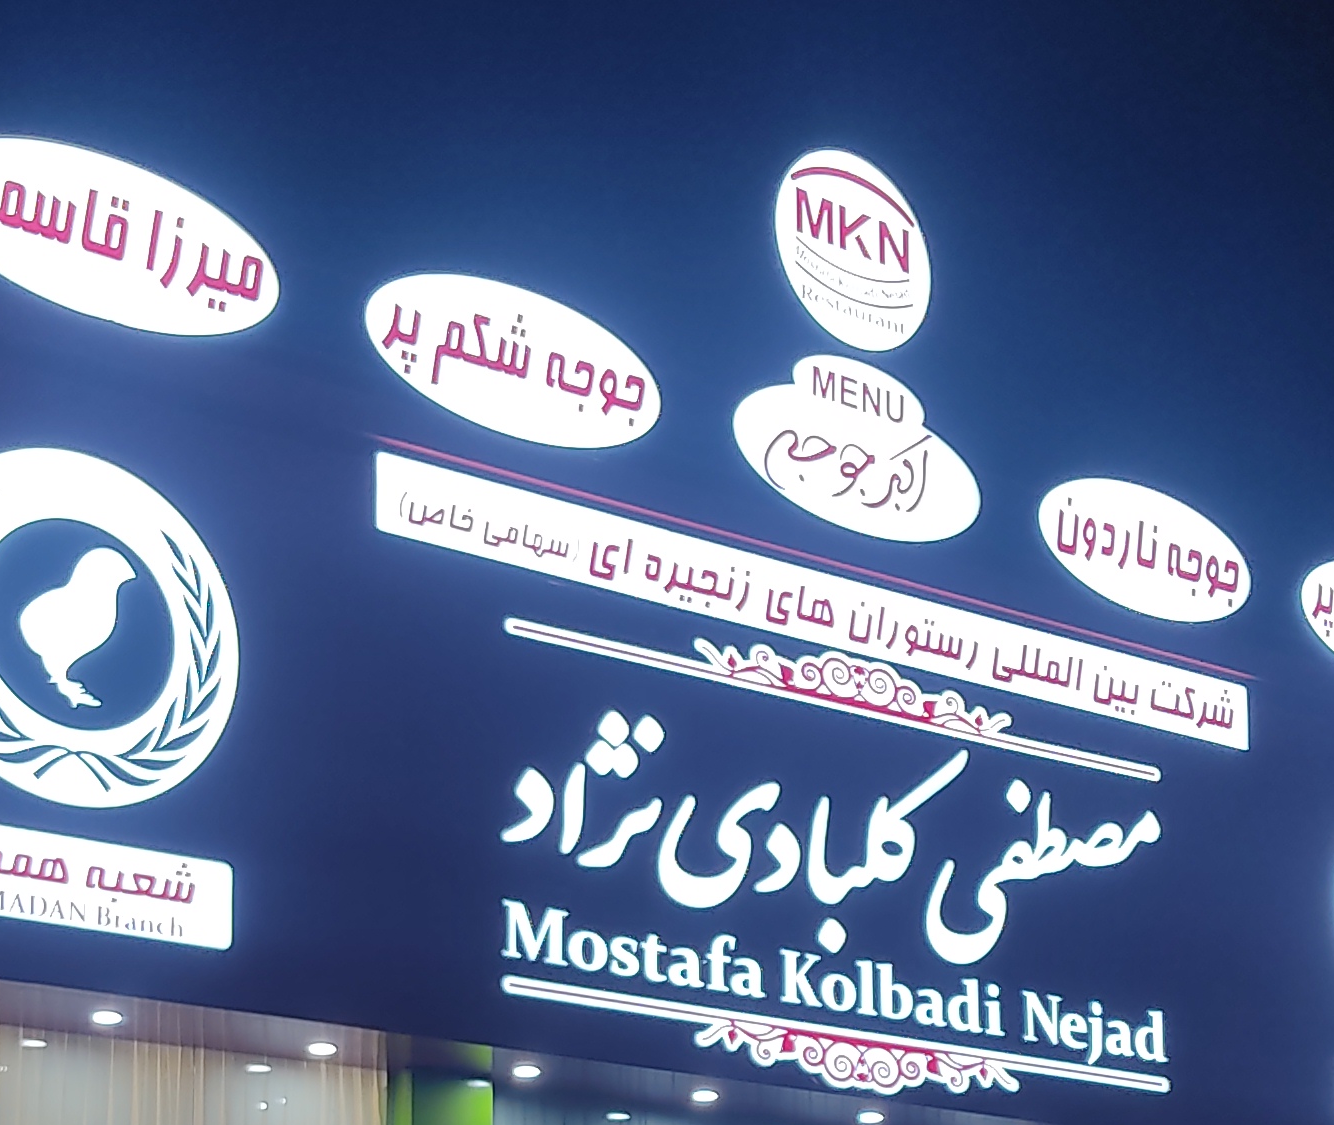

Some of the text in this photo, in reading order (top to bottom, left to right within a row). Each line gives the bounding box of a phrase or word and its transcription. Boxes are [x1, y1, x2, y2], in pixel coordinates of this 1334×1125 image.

[796, 187, 909, 274] MKN
[146, 209, 263, 312] میرزا
[382, 303, 646, 427] جوجه شکم پر
[813, 366, 904, 423] MENU
[764, 429, 932, 513] اکبر جوجه
[589, 538, 634, 580] ای
[1057, 497, 1240, 607] جوجه ناردون
[644, 553, 751, 611] زنجیره
[766, 586, 835, 627] های
[1312, 583, 1333, 637] پر
[849, 601, 979, 669] رستوران
[992, 645, 1083, 690] المللی
[1094, 665, 1139, 715] بین
[1150, 678, 1233, 729] شرکت
[500, 709, 1161, 965] مصطفی کلبادی نژاد
[86, 862, 196, 904] شعبه
[97, 904, 183, 938] Branch
[501, 898, 1169, 1065] Mostafa Kolbadi Nejad
